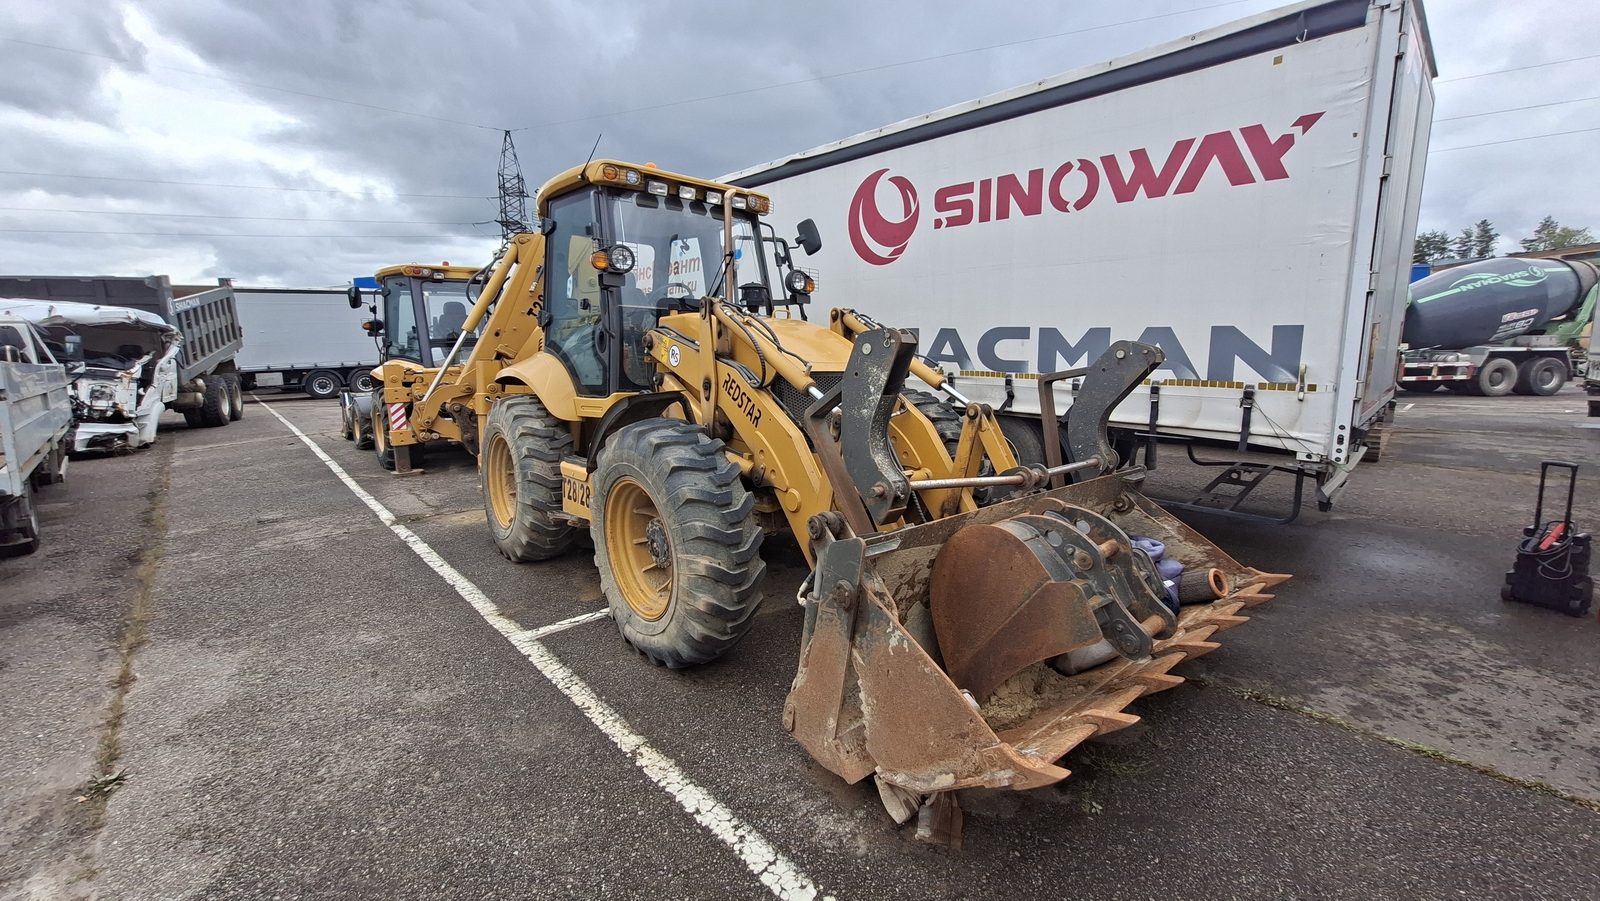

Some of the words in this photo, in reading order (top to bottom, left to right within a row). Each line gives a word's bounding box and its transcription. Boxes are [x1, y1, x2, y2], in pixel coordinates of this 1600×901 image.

[933, 111, 1326, 230] SINOWAY
[1460, 270, 1530, 292] SHACMAN
[905, 325, 1305, 381] ACMAN
[722, 373, 762, 429] REDSTAR
